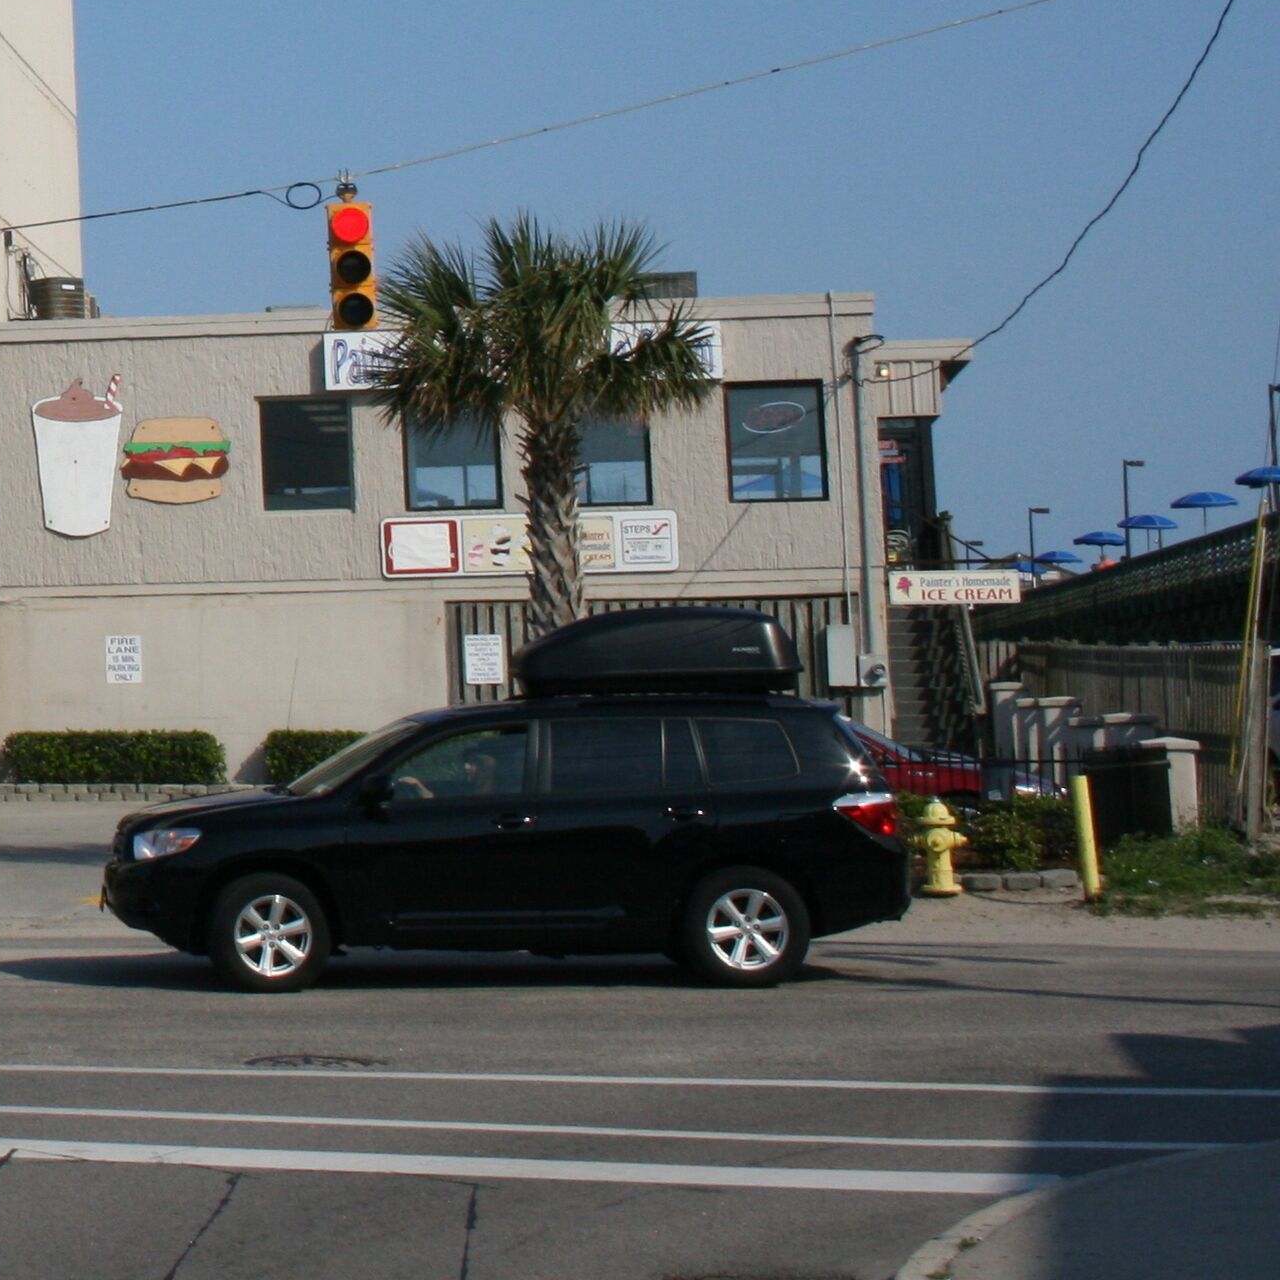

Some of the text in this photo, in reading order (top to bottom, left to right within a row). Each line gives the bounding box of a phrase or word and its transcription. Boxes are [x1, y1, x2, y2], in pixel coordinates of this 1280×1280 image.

[623, 524, 651, 534] STEPS
[962, 575, 1010, 587] Homemade
[921, 588, 1013, 600] ICE CREAM
[110, 637, 137, 645] FIRE
[107, 646, 140, 654] LANE
[114, 673, 133, 681] ONLY
